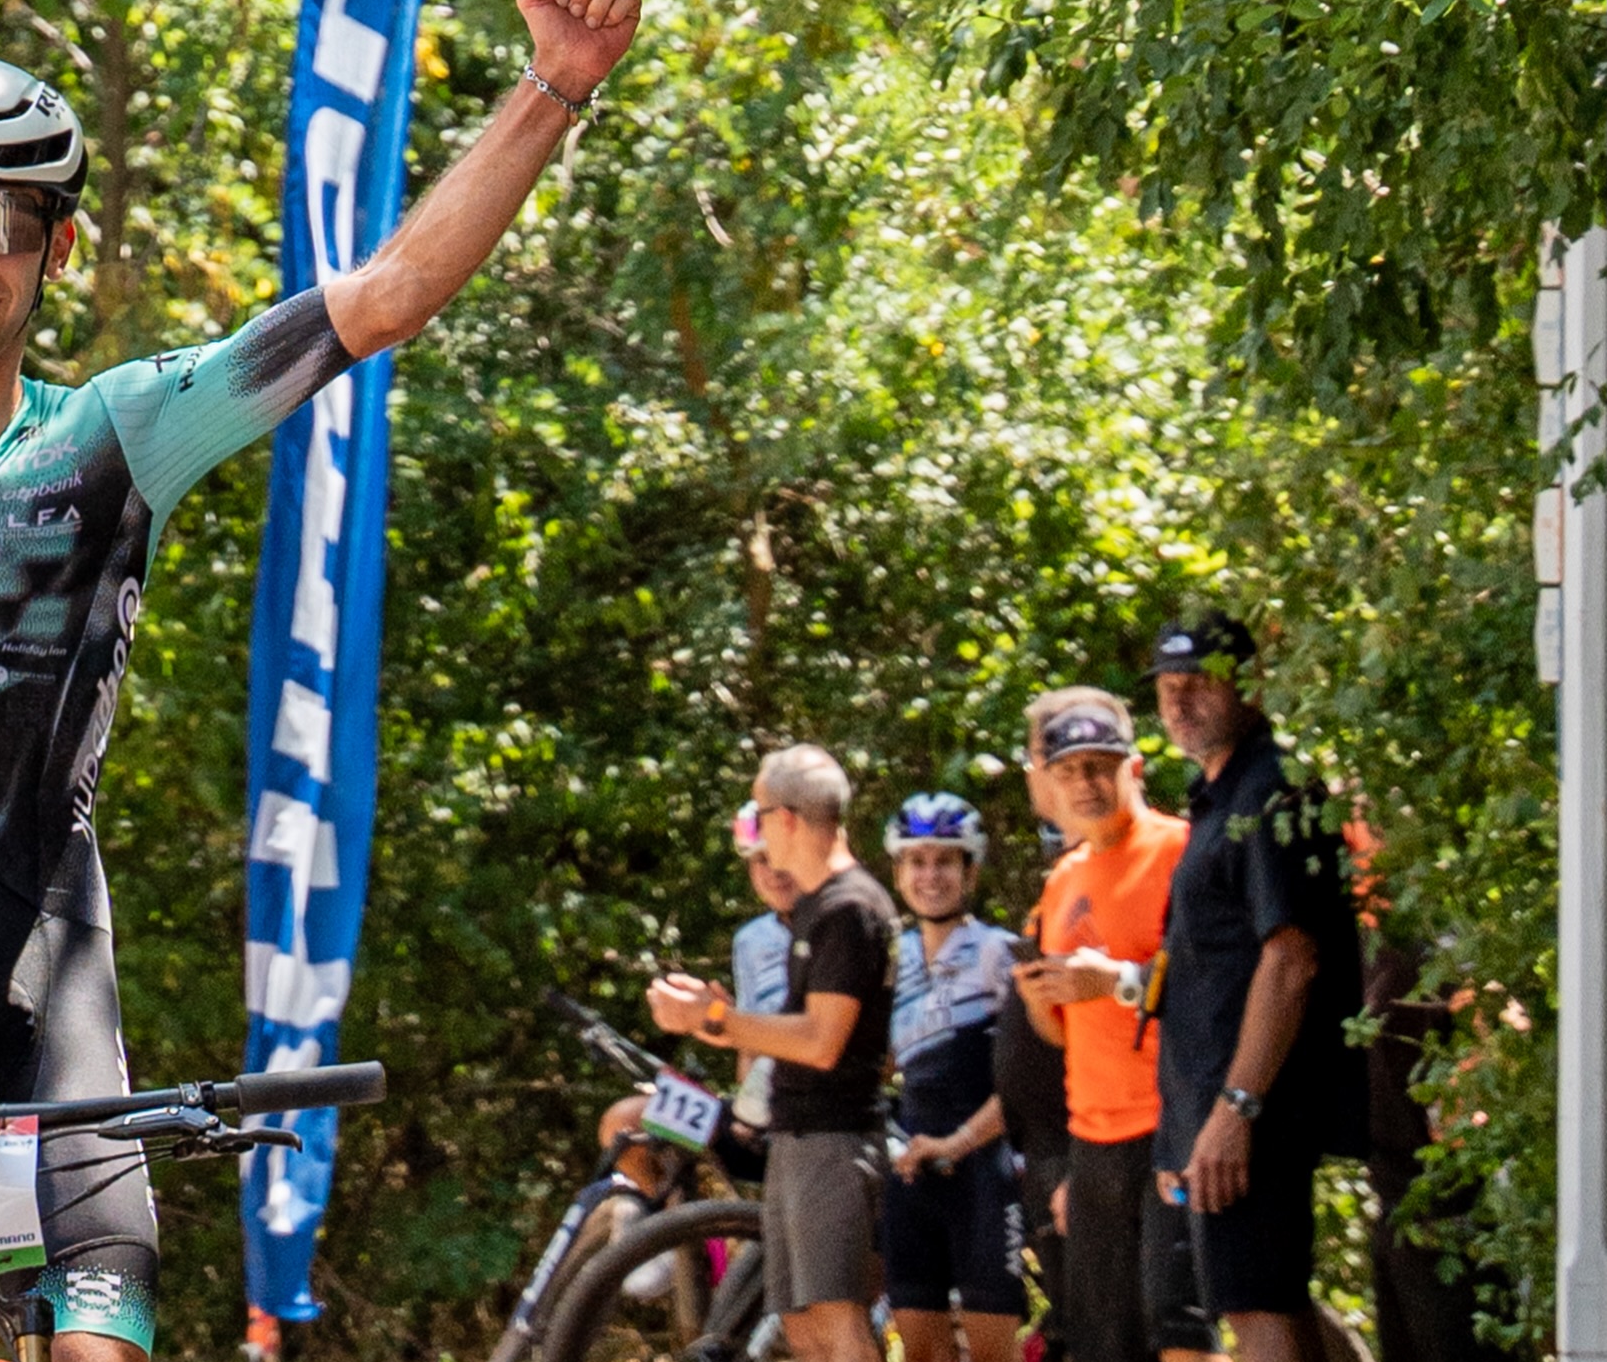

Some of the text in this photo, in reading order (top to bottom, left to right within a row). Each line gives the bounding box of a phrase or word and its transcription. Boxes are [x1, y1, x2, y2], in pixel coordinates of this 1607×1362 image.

[1, 642, 68, 658] Holiday Inn
[656, 1085, 708, 1130] 112
